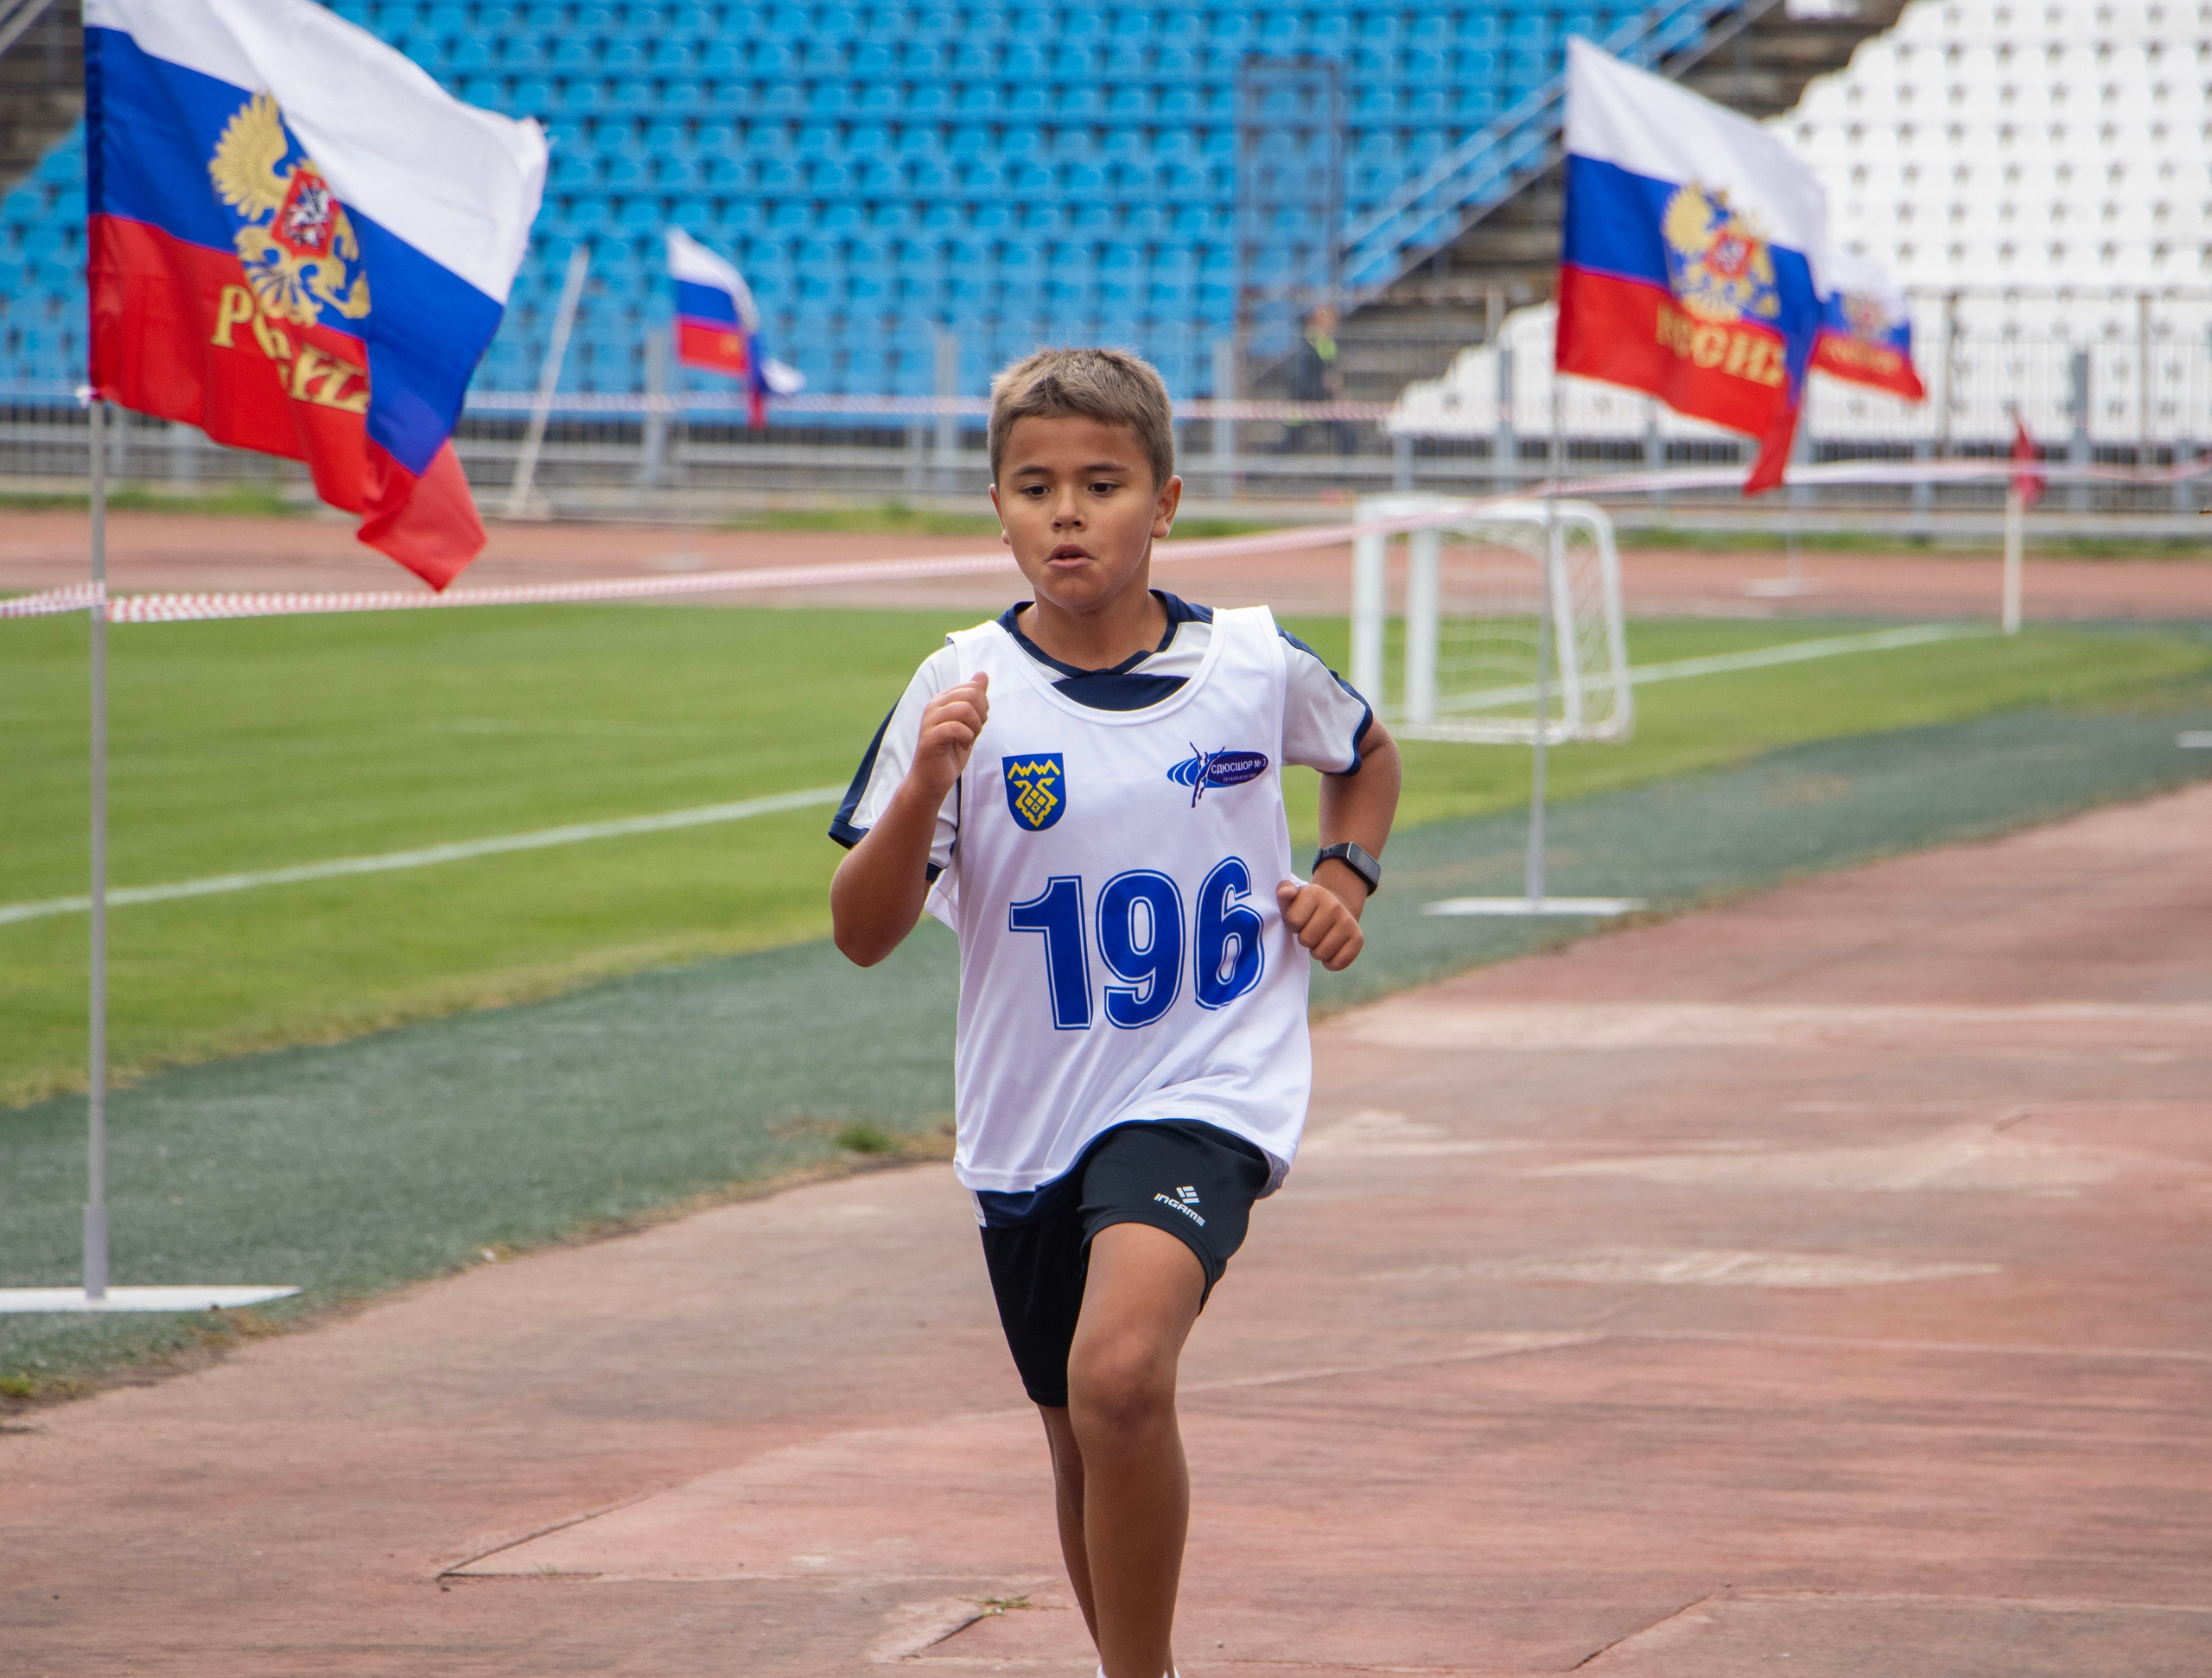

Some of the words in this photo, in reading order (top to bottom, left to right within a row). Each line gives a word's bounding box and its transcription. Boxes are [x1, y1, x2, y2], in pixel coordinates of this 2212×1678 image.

[1211, 760, 1253, 775] СДЮСШОР
[1262, 757, 1267, 767] 3
[1009, 855, 1264, 1030] 196
[1154, 1193, 1205, 1227] INGAME
